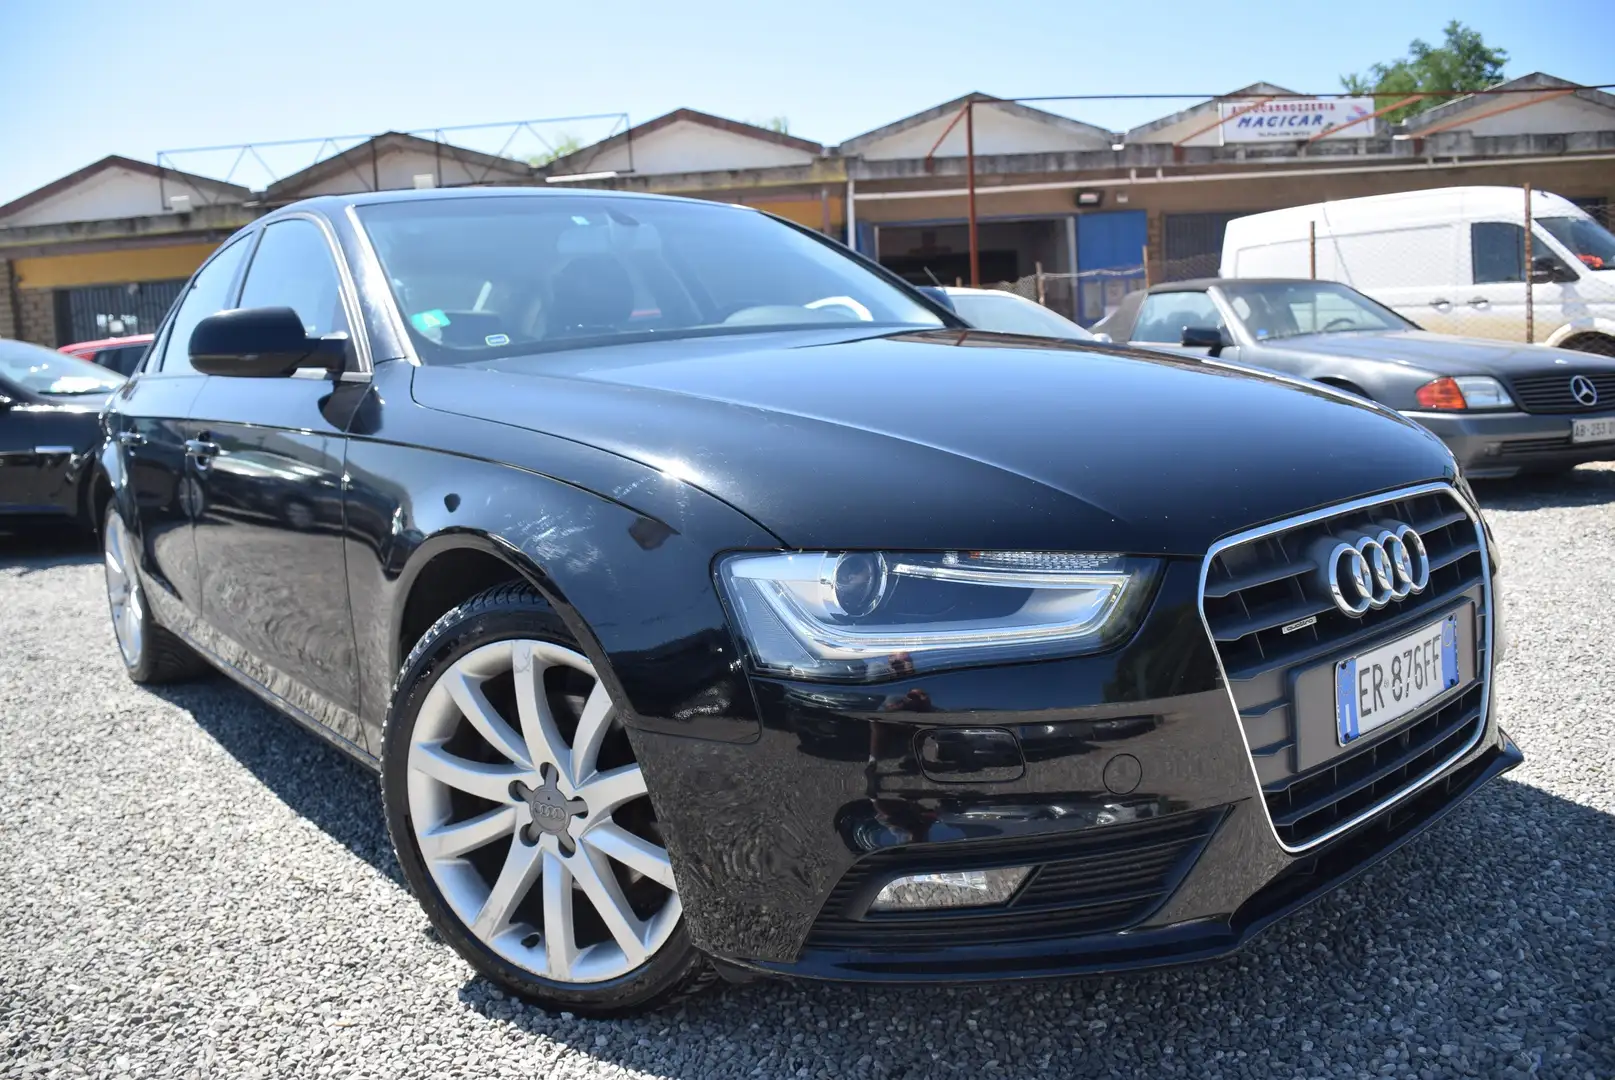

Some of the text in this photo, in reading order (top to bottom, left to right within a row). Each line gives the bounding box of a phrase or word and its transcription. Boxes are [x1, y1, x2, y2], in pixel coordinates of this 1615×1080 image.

[1237, 114, 1324, 128] MAGICAR
[1358, 634, 1442, 718] ER 876FF
